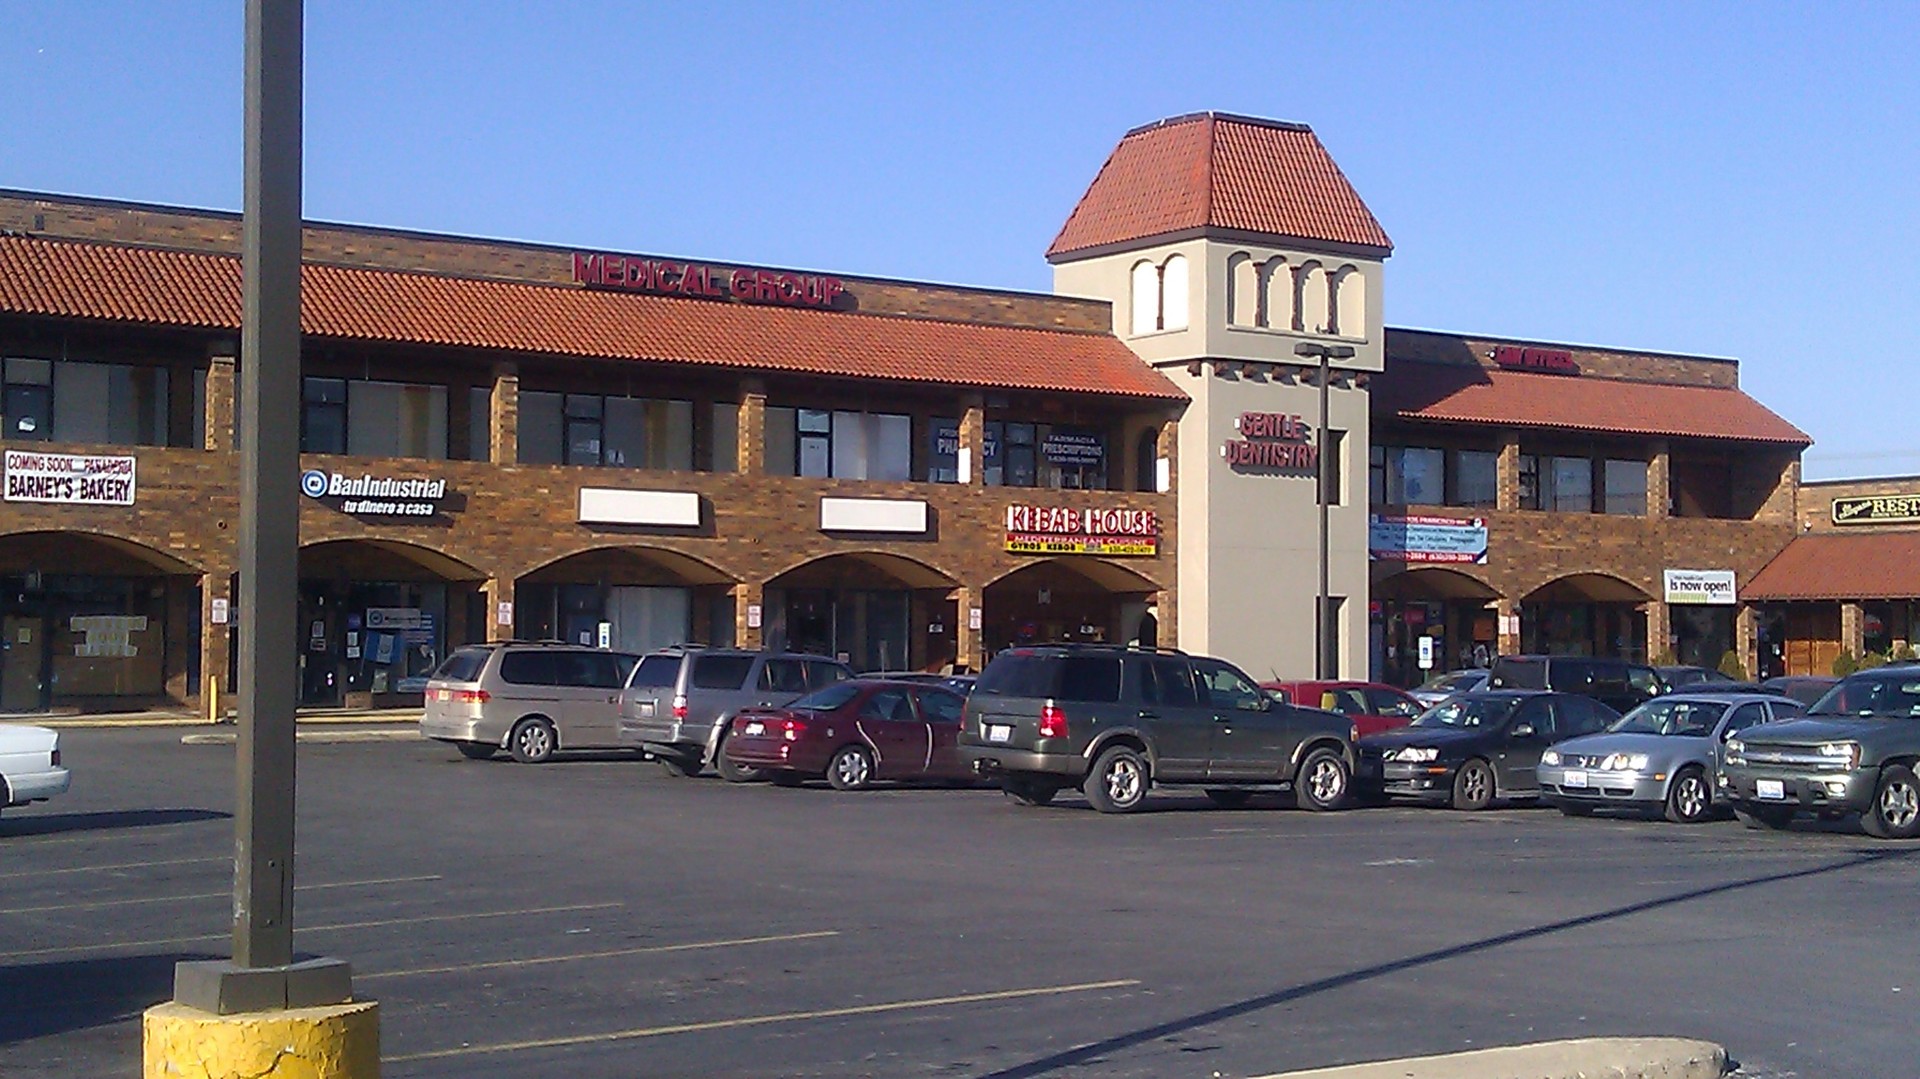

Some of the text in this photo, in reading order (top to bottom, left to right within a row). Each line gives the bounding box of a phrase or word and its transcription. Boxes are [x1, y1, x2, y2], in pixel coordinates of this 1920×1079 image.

[571, 252, 846, 304] MEDICAL GROUP
[1241, 411, 1302, 438] GENTLE
[1049, 435, 1096, 444] FARMACIA
[1042, 443, 1103, 457] PRESCRIPTIONS
[1225, 440, 1317, 468] DENTISTRY
[8, 455, 45, 470] COMING
[47, 457, 73, 472] SOON
[9, 475, 131, 501] BARNEY'S BAKERY
[329, 473, 446, 498] BanIndustrial
[344, 500, 434, 515] tu dinero a casa
[1007, 505, 1157, 535] KEBAB HOUSE
[1010, 542, 1041, 550] GYROS
[1014, 535, 1103, 544] MEDITERRANEAN
[1680, 582, 1701, 591] now
[1704, 580, 1731, 593] open!
